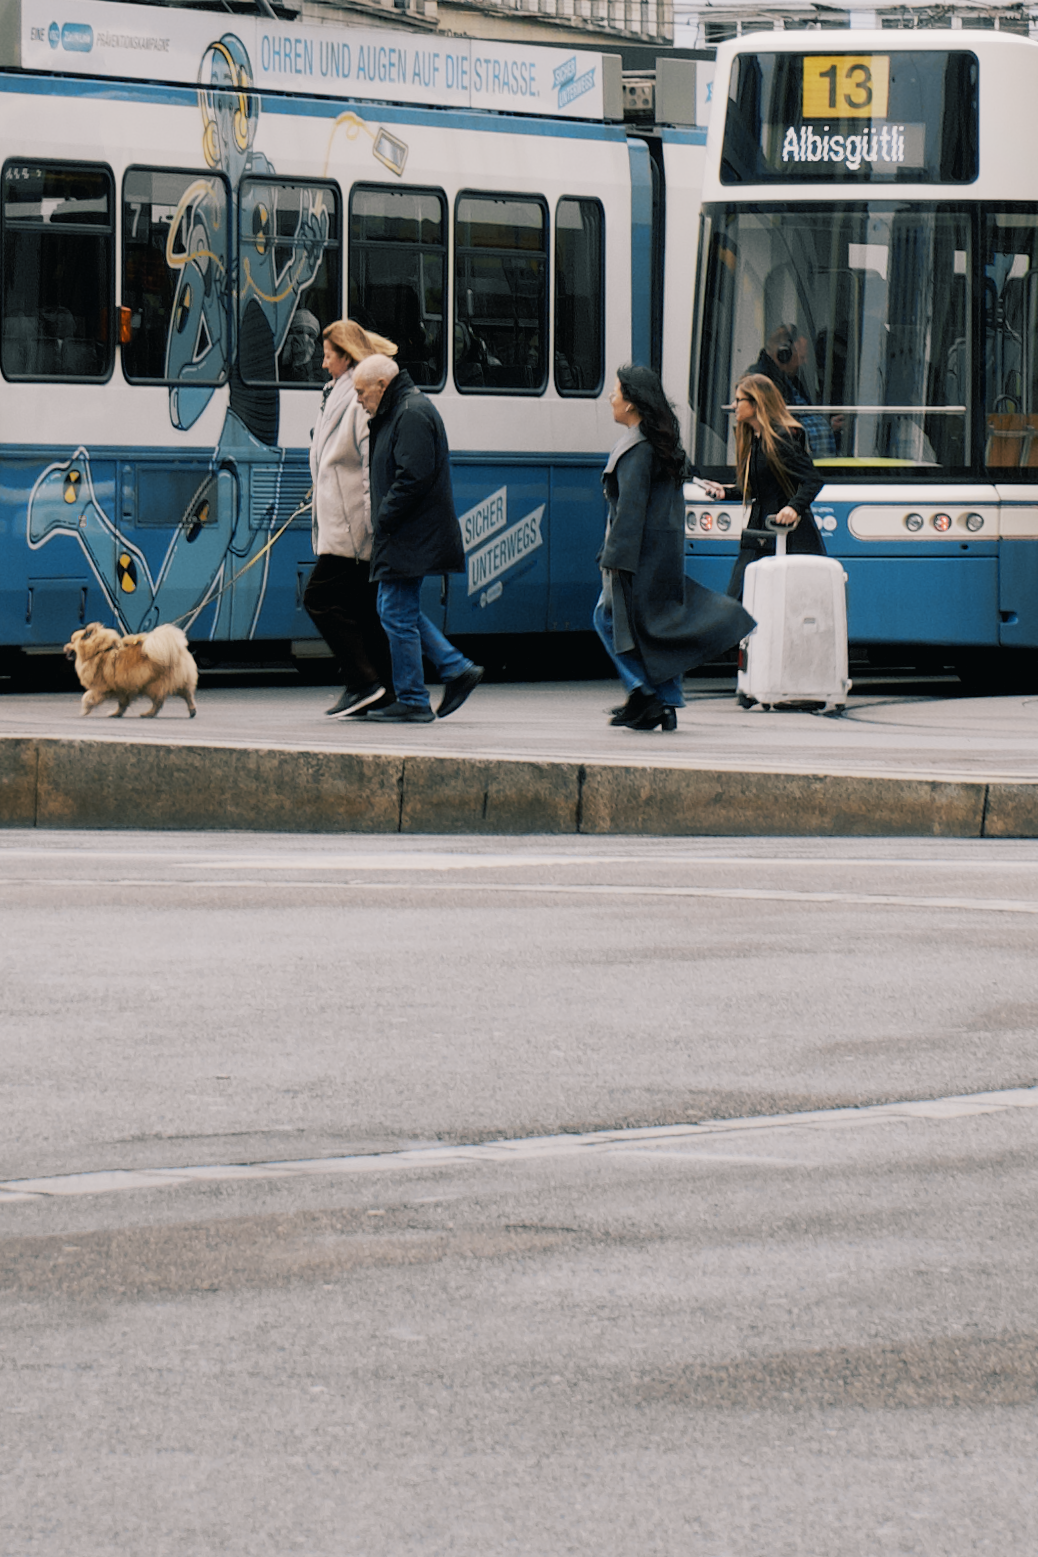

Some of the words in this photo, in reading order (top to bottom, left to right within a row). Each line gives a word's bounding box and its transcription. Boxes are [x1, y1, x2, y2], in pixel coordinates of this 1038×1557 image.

[30, 27, 45, 42] EINE
[261, 35, 313, 76] OHREN
[320, 41, 351, 78] UND
[356, 45, 407, 84] AUGEN
[412, 50, 440, 88] AUF
[445, 54, 468, 91] DIE
[474, 57, 540, 97] STRASSE.
[819, 64, 873, 109] 13
[782, 125, 904, 170] Albisgütli
[465, 496, 503, 545] SICHER
[472, 517, 537, 586] UNTERWEGS
